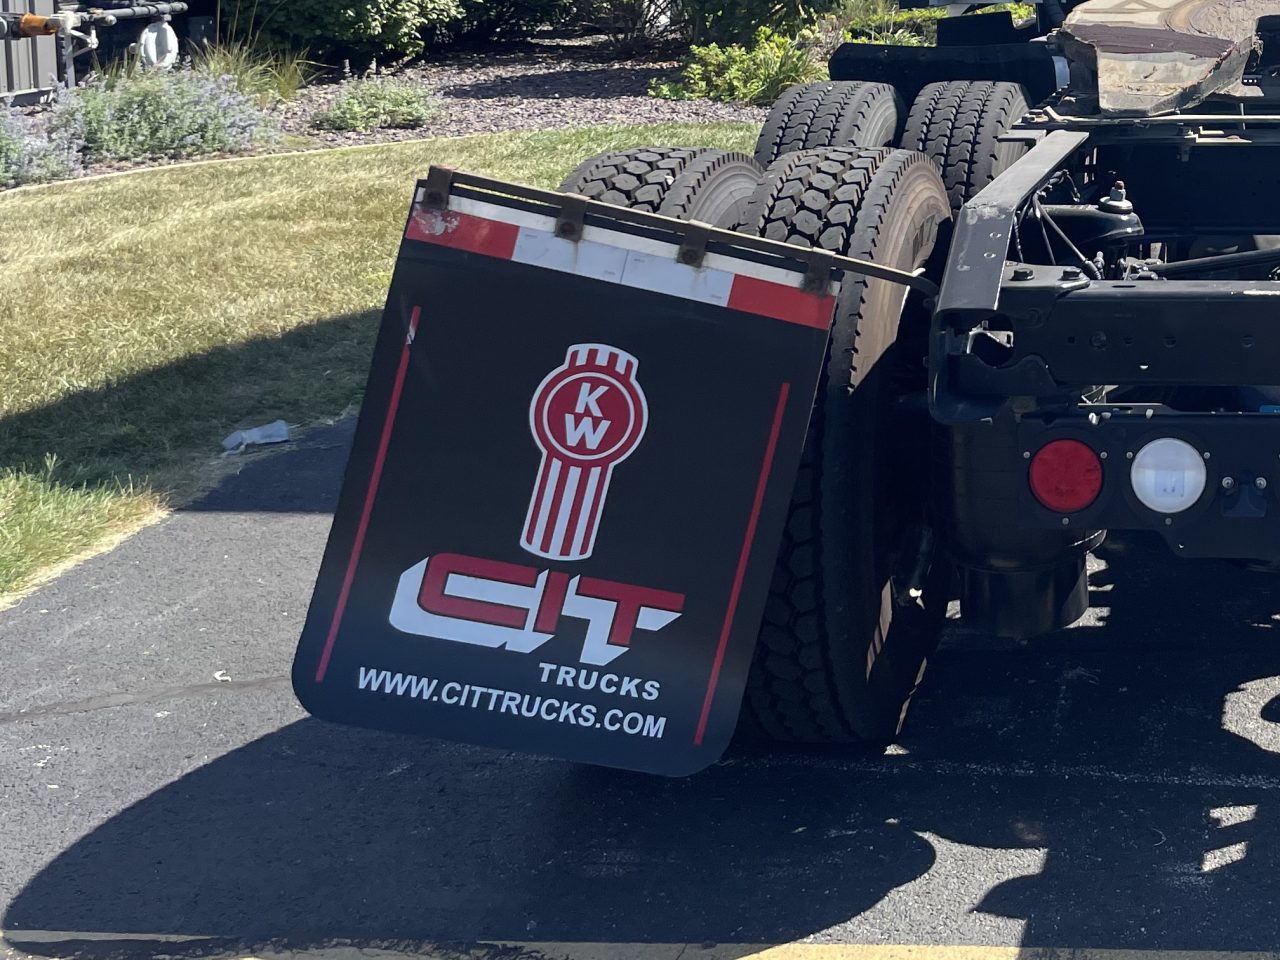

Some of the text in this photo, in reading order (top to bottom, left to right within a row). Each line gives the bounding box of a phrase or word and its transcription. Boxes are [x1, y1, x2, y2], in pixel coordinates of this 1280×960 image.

[389, 554, 684, 666] CIT
[358, 667, 667, 739] WWW.CITTRUCKS.COM
[539, 663, 661, 701] TRUCKS
